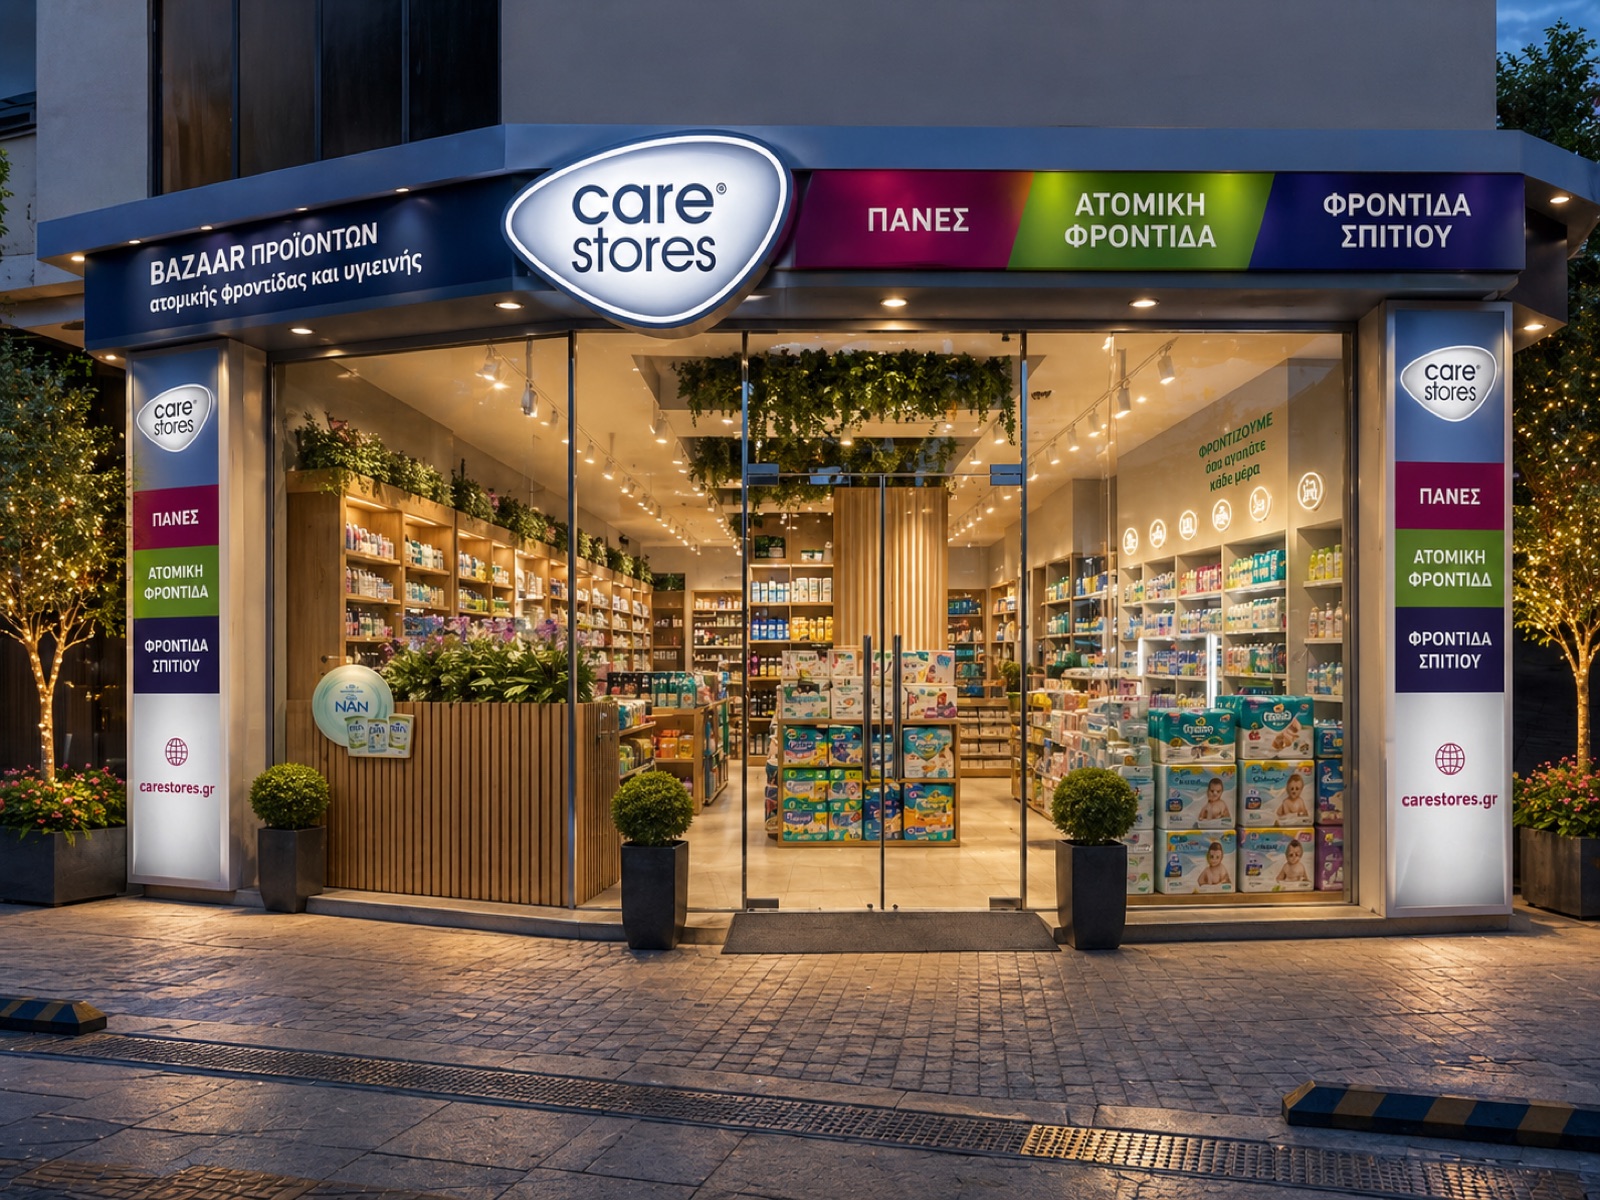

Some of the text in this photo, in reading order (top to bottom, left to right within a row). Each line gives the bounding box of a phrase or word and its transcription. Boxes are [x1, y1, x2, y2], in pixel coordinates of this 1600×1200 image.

[1075, 192, 1205, 217] ΑΤΟΜΙΚΗ
[1324, 192, 1472, 217] ΦΡΟΝΤΙΔΑ
[868, 207, 969, 232] ΠΑΝΕΣ
[1064, 223, 1217, 248] ΦΡΟΝΤΙΔΑ
[1341, 224, 1453, 248] ΣΠΙΤΙΟΥ
[150, 222, 378, 286] BAZAAR ΠΡΟΪΟΝΤΩΝ
[572, 227, 716, 273] stores
[150, 249, 422, 313] ατομικής φροντίδας και υγιεινής
[1425, 381, 1476, 401] stores
[154, 419, 194, 436] stores
[1419, 488, 1481, 505] ΠΑΝΕΣ
[152, 509, 199, 527] ΠΑΝΕΣ
[1413, 549, 1486, 565] ΑΤΟΜΙΚΗ
[148, 564, 203, 580] ΑΤΟΜΙΚΗ
[144, 584, 209, 600] ΦΡΟΝΤΙΔΑ
[144, 638, 209, 653] ΦΡΟΝΤΙΔΑ
[1408, 630, 1492, 647] ΦΡΟΝΤΙΔΑ
[152, 659, 201, 673] ΣΠΙΤΙΟΥ
[1419, 653, 1482, 669] ΣΠΙΤΙΟΥ
[335, 700, 369, 713] NAN
[139, 781, 216, 798] carestores.gr
[1401, 792, 1499, 810] carestores.gr
